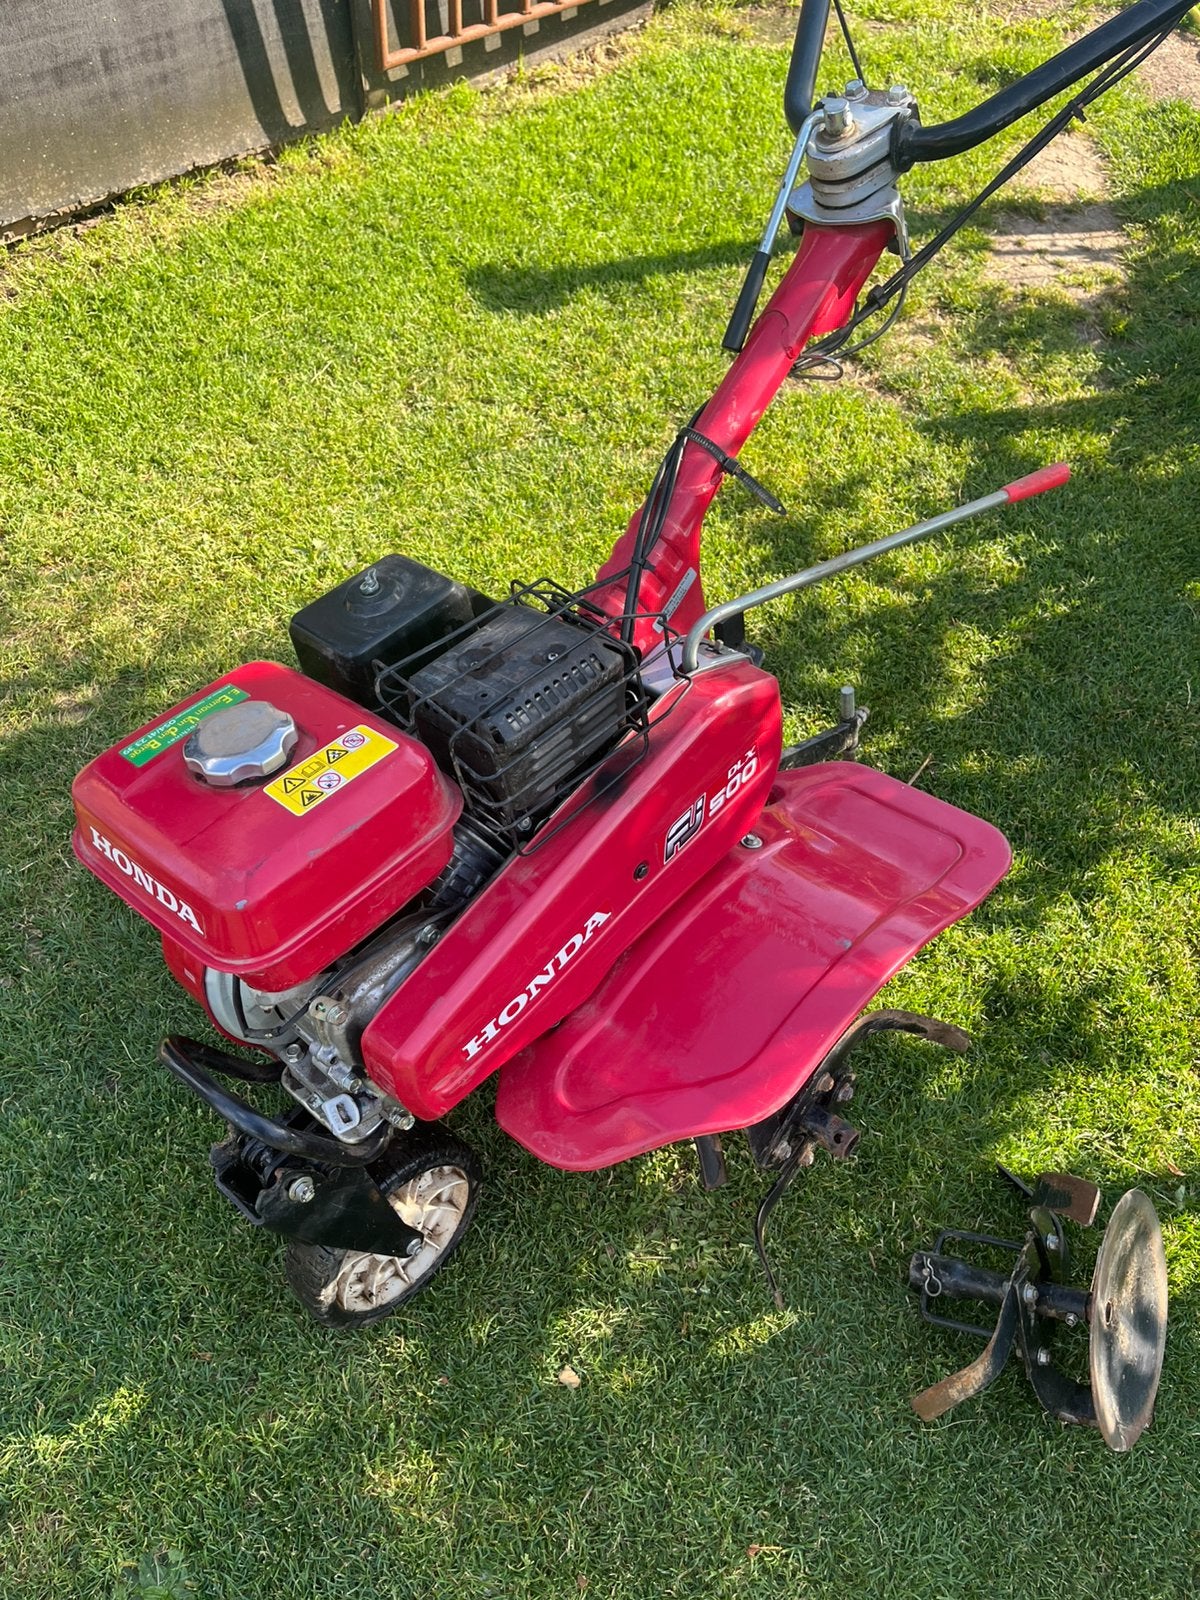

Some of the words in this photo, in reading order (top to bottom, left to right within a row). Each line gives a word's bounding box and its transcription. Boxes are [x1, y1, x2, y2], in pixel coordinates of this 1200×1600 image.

[158, 726, 178, 739] den
[177, 715, 200, 726] Van
[129, 739, 162, 758] Berge
[728, 745, 756, 779] DLX
[664, 792, 706, 865] FJ
[708, 757, 758, 817] 500
[89, 825, 204, 936] HONDA
[461, 911, 612, 1061] HONDA
